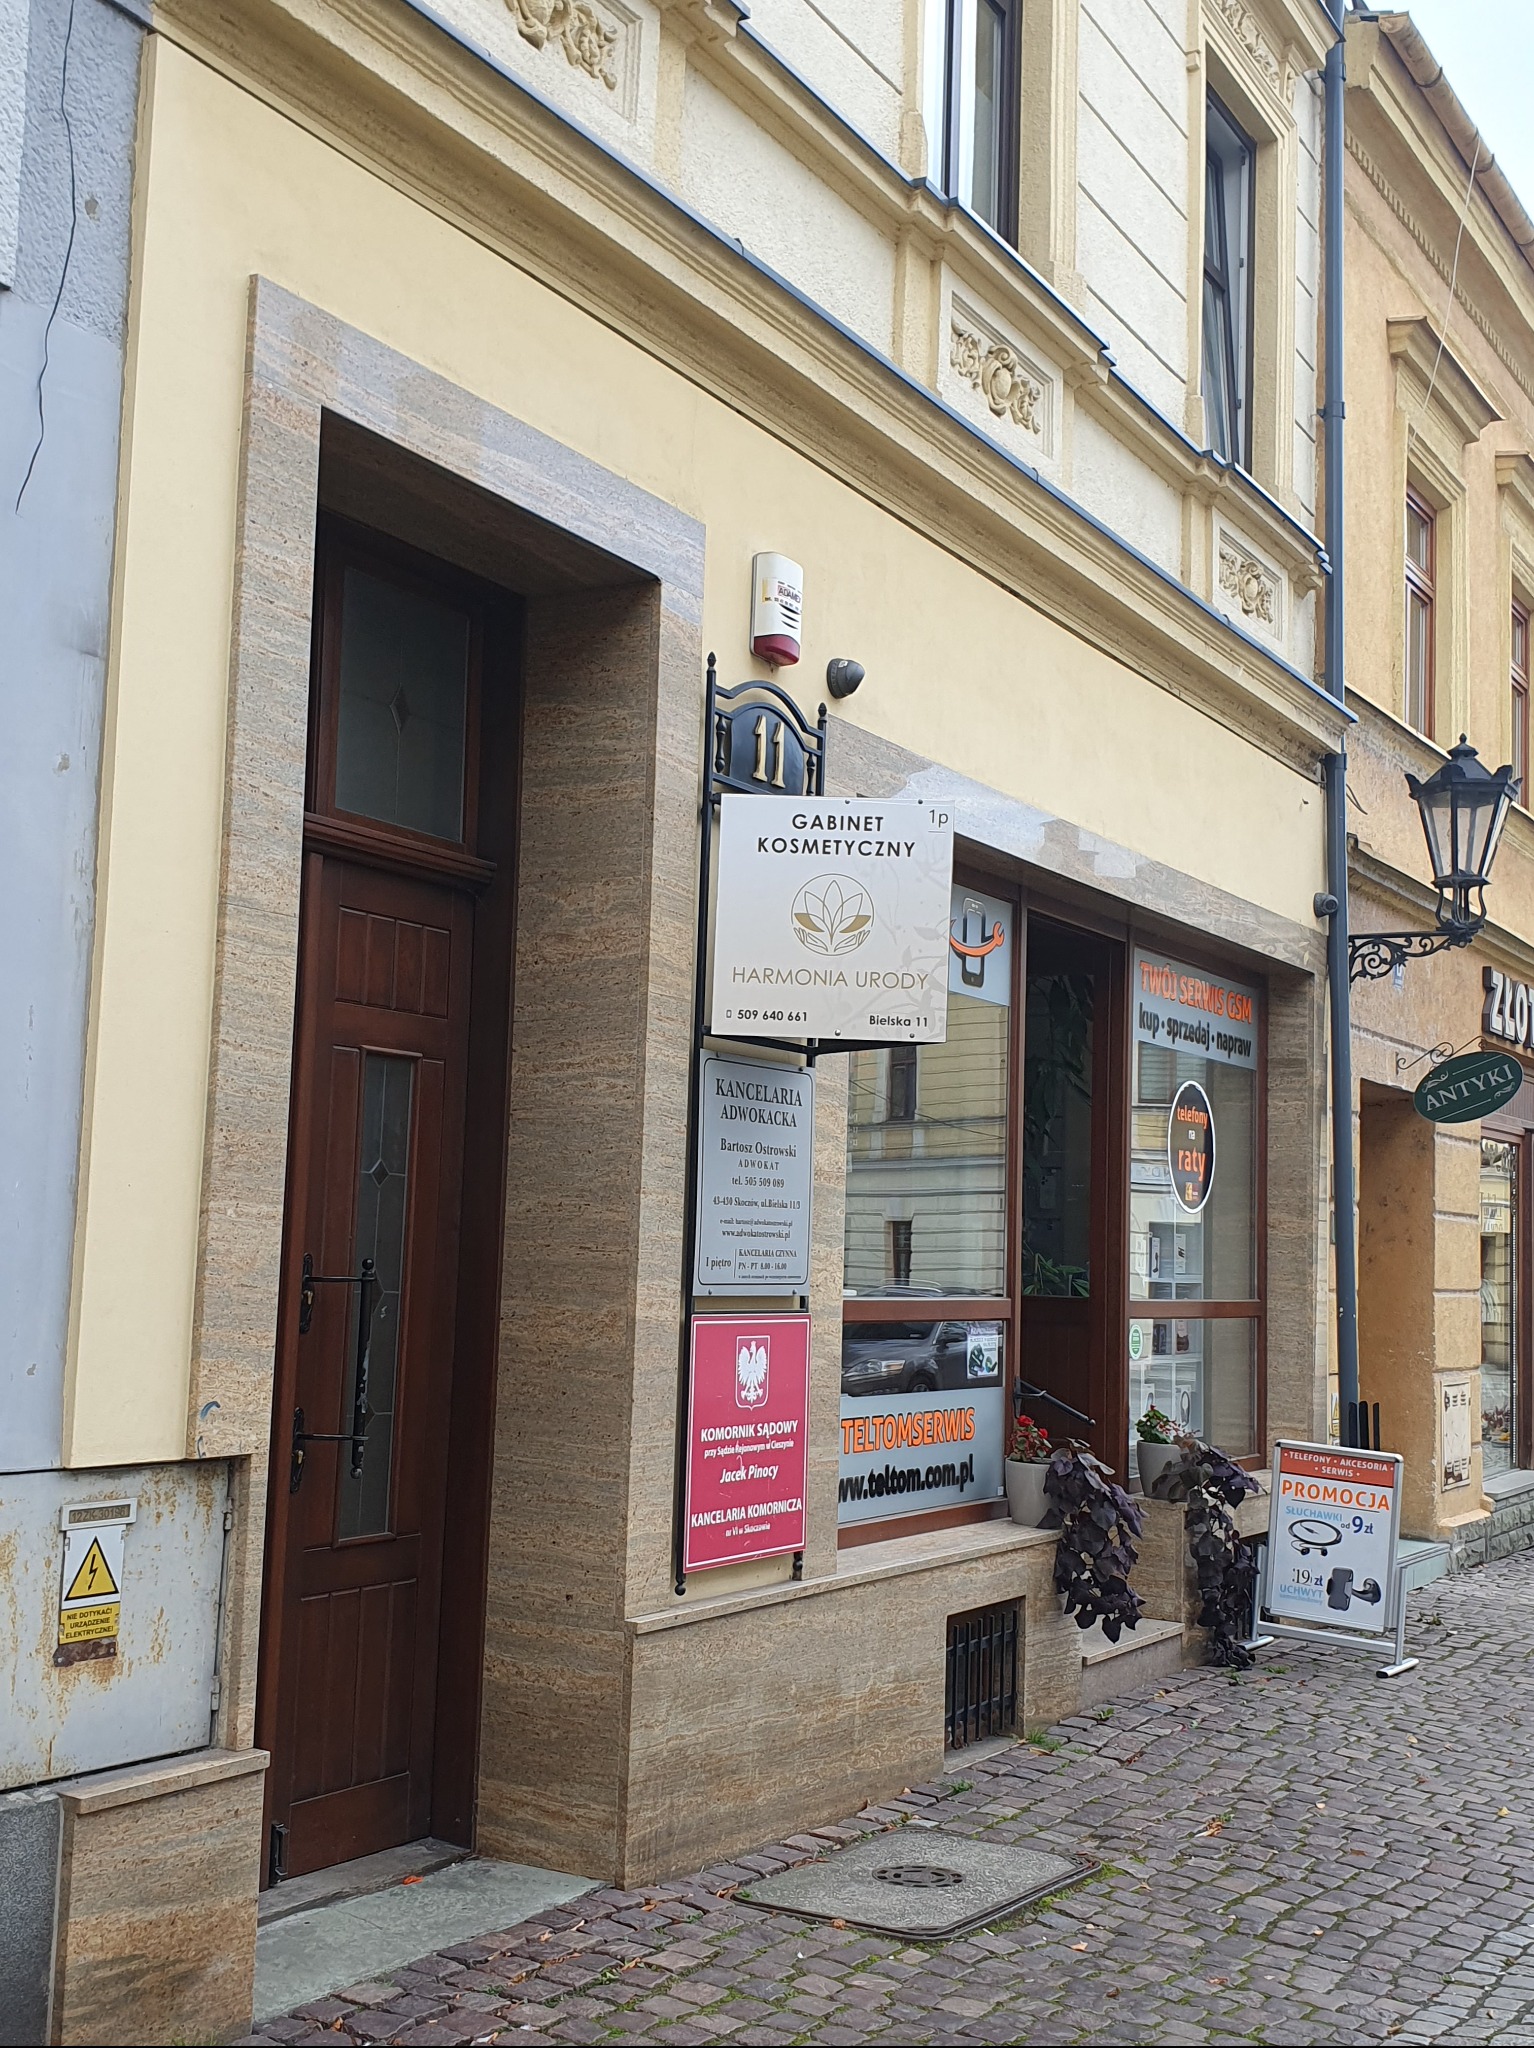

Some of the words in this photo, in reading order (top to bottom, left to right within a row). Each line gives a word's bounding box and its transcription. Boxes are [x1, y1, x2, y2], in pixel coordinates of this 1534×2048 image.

[753, 714, 786, 788] 11
[791, 813, 884, 832] GABINET
[928, 809, 949, 828] 1p
[757, 837, 915, 857] KOSMETYCZNY
[732, 966, 848, 987] HARMONIA
[855, 971, 929, 990] URODY
[1139, 962, 1177, 1002] TWÓJ
[1179, 977, 1225, 1017] SERWIS
[1226, 993, 1252, 1024] GSM
[737, 1009, 759, 1020] 509
[762, 1010, 784, 1021] 640
[787, 1011, 808, 1022] 661
[869, 1014, 911, 1027] Bielska
[915, 1016, 928, 1027] 11
[1138, 1002, 1160, 1039] kup
[1166, 1012, 1210, 1052] sprzedaj
[1216, 1029, 1251, 1059] napraw
[715, 1078, 803, 1107] KANCELARIA
[1425, 1063, 1515, 1112] ANTYKI
[720, 1103, 797, 1127] ADWOKACKA
[1177, 1105, 1209, 1130] telefony
[1188, 1130, 1196, 1140] na
[720, 1138, 753, 1154] Bartosz
[755, 1141, 797, 1158] Ostrowski
[738, 1159, 780, 1171] ADWOKAT
[1178, 1146, 1206, 1182] raty
[732, 1176, 742, 1185] tel.
[744, 1177, 757, 1187] 505
[759, 1177, 771, 1187] 509
[772, 1178, 785, 1188] 089
[738, 1249, 774, 1257] KANCELARIA
[711, 1257, 732, 1270] piętro
[700, 1423, 755, 1442] KOMORNIK
[757, 1420, 798, 1439] SĄDOWY
[841, 1407, 976, 1454] TELTOMSERWIS
[704, 1449, 717, 1459] przy
[717, 1445, 735, 1457] Sądzie
[1289, 1451, 1331, 1464] TELEFONY
[1339, 1458, 1388, 1471] AKCESORIA
[720, 1464, 747, 1484] Jacek
[748, 1464, 779, 1482] Pinocy
[838, 1453, 975, 1504] ww.teltom.com.pl
[1321, 1465, 1354, 1477] SERWIS
[1281, 1479, 1390, 1511] PROMOCJA
[691, 1506, 746, 1528] KANCELARIA
[747, 1498, 803, 1518] KOMORNICZA
[1285, 1505, 1343, 1522] SŁUCHAWKI
[1340, 1521, 1350, 1530] od
[1280, 1584, 1324, 1599] UCHWYT
[66, 1611, 79, 1621] NIE
[69, 1617, 111, 1630] URZĄDZENIE
